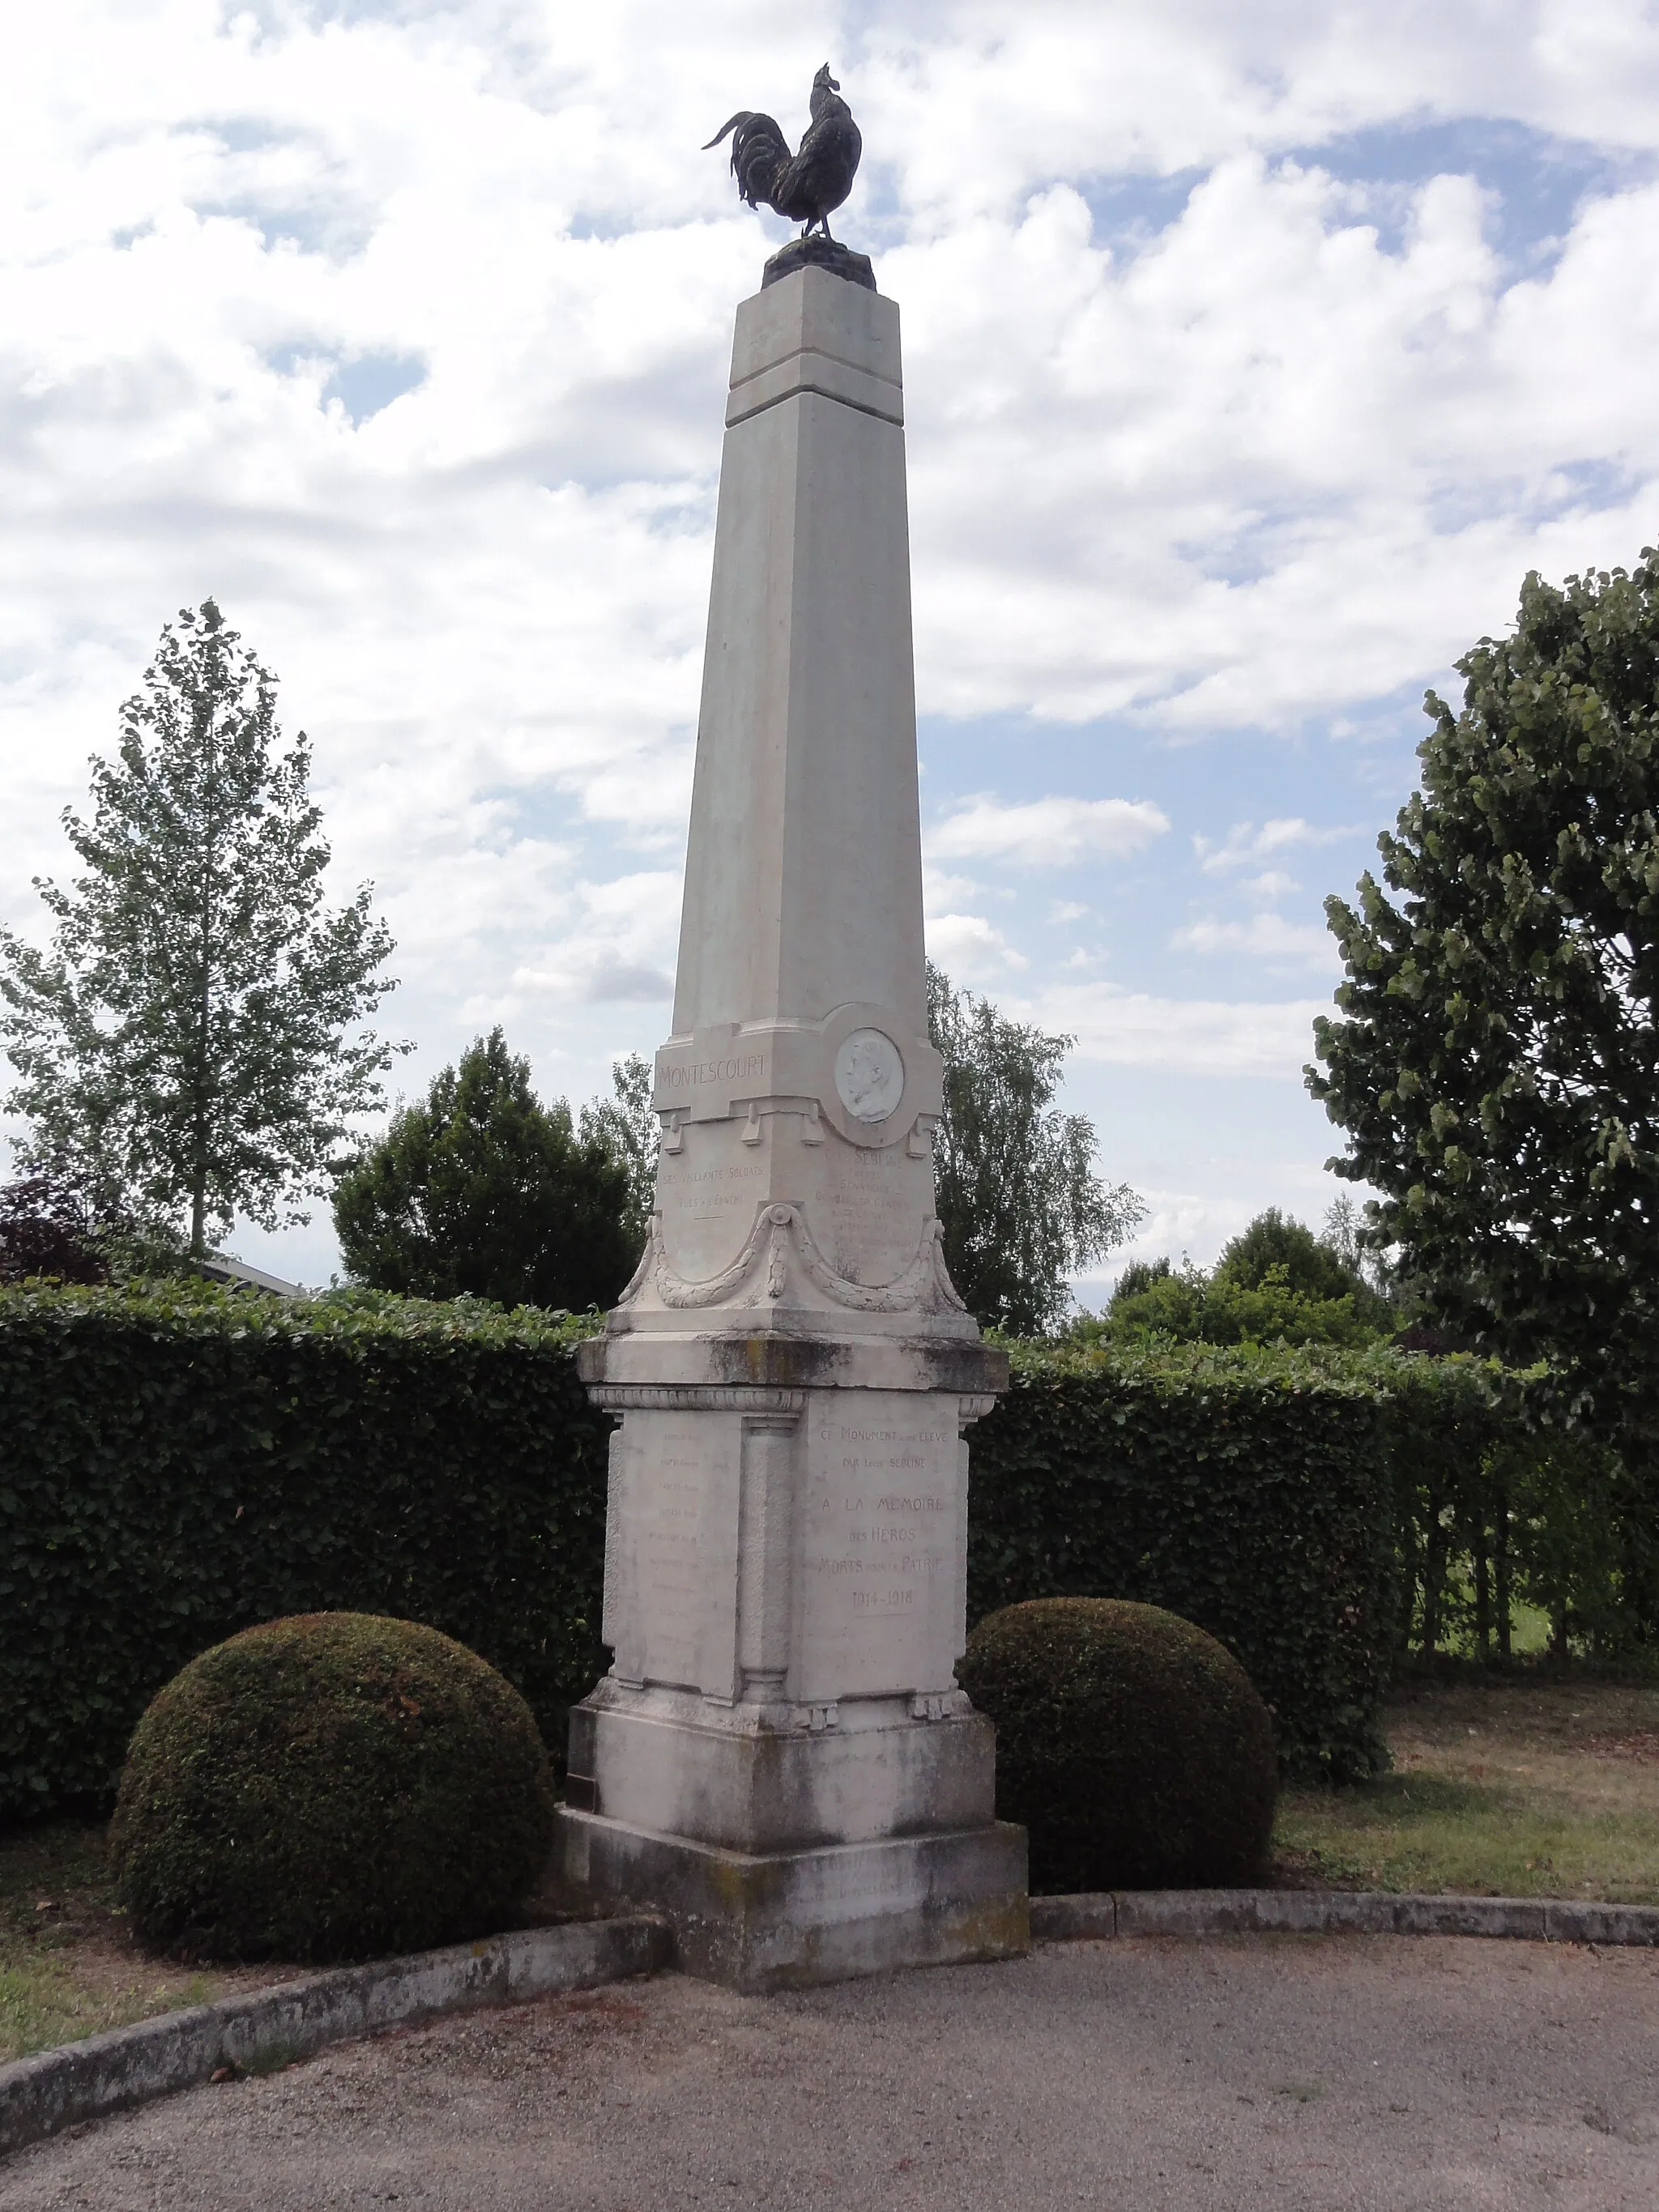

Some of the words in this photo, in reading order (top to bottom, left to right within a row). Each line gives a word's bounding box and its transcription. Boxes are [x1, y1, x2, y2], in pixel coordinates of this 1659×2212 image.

[659, 1055, 766, 1089] MONTESCOURT
[681, 1169, 723, 1183] VAILLANTS
[728, 1166, 763, 1179] SOLDATS
[821, 1430, 833, 1441] CE
[841, 1426, 897, 1442] MONUMENT
[842, 1457, 859, 1468] PAR
[821, 1498, 831, 1511] A
[845, 1497, 864, 1511] LA
[818, 1557, 864, 1575] MORTS
[902, 1555, 943, 1573] PATRIE
[852, 1588, 914, 1609] 1914-1918
